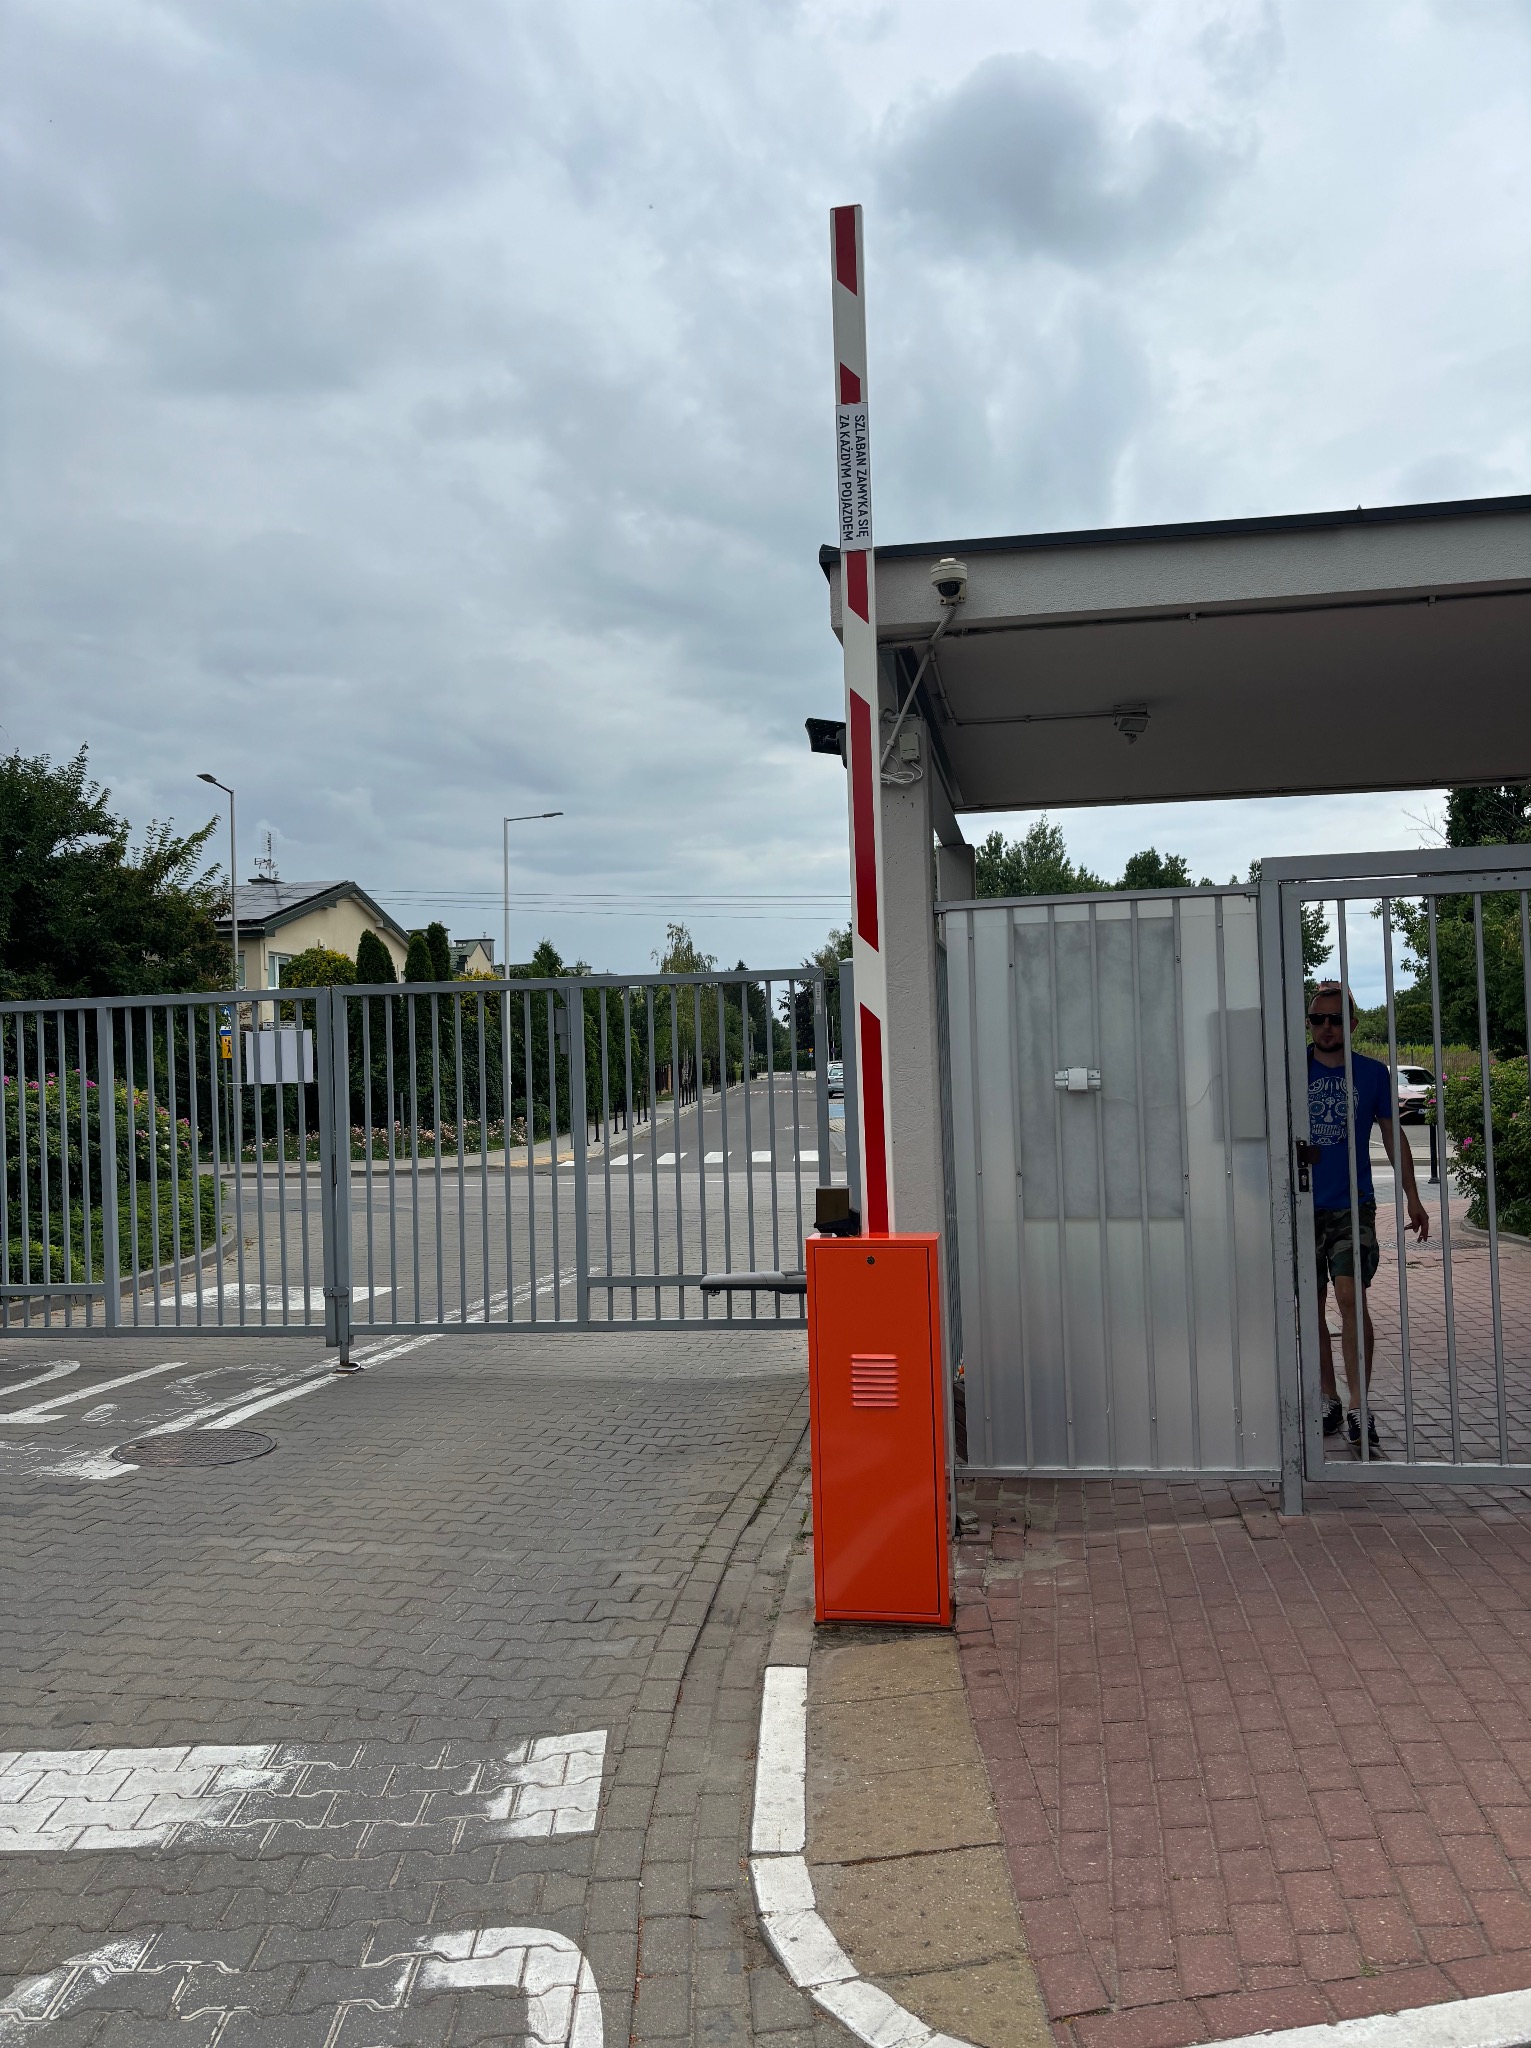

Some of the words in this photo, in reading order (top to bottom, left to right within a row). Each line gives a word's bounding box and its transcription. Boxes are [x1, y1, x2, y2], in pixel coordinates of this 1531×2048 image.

[839, 414, 850, 429] ZA
[855, 414, 867, 466] SZLABAN
[839, 431, 853, 478] KAŻDYM
[841, 481, 854, 541] POJAZDEM
[856, 469, 868, 517] ZAMYKA
[856, 519, 869, 537] SIĘ
